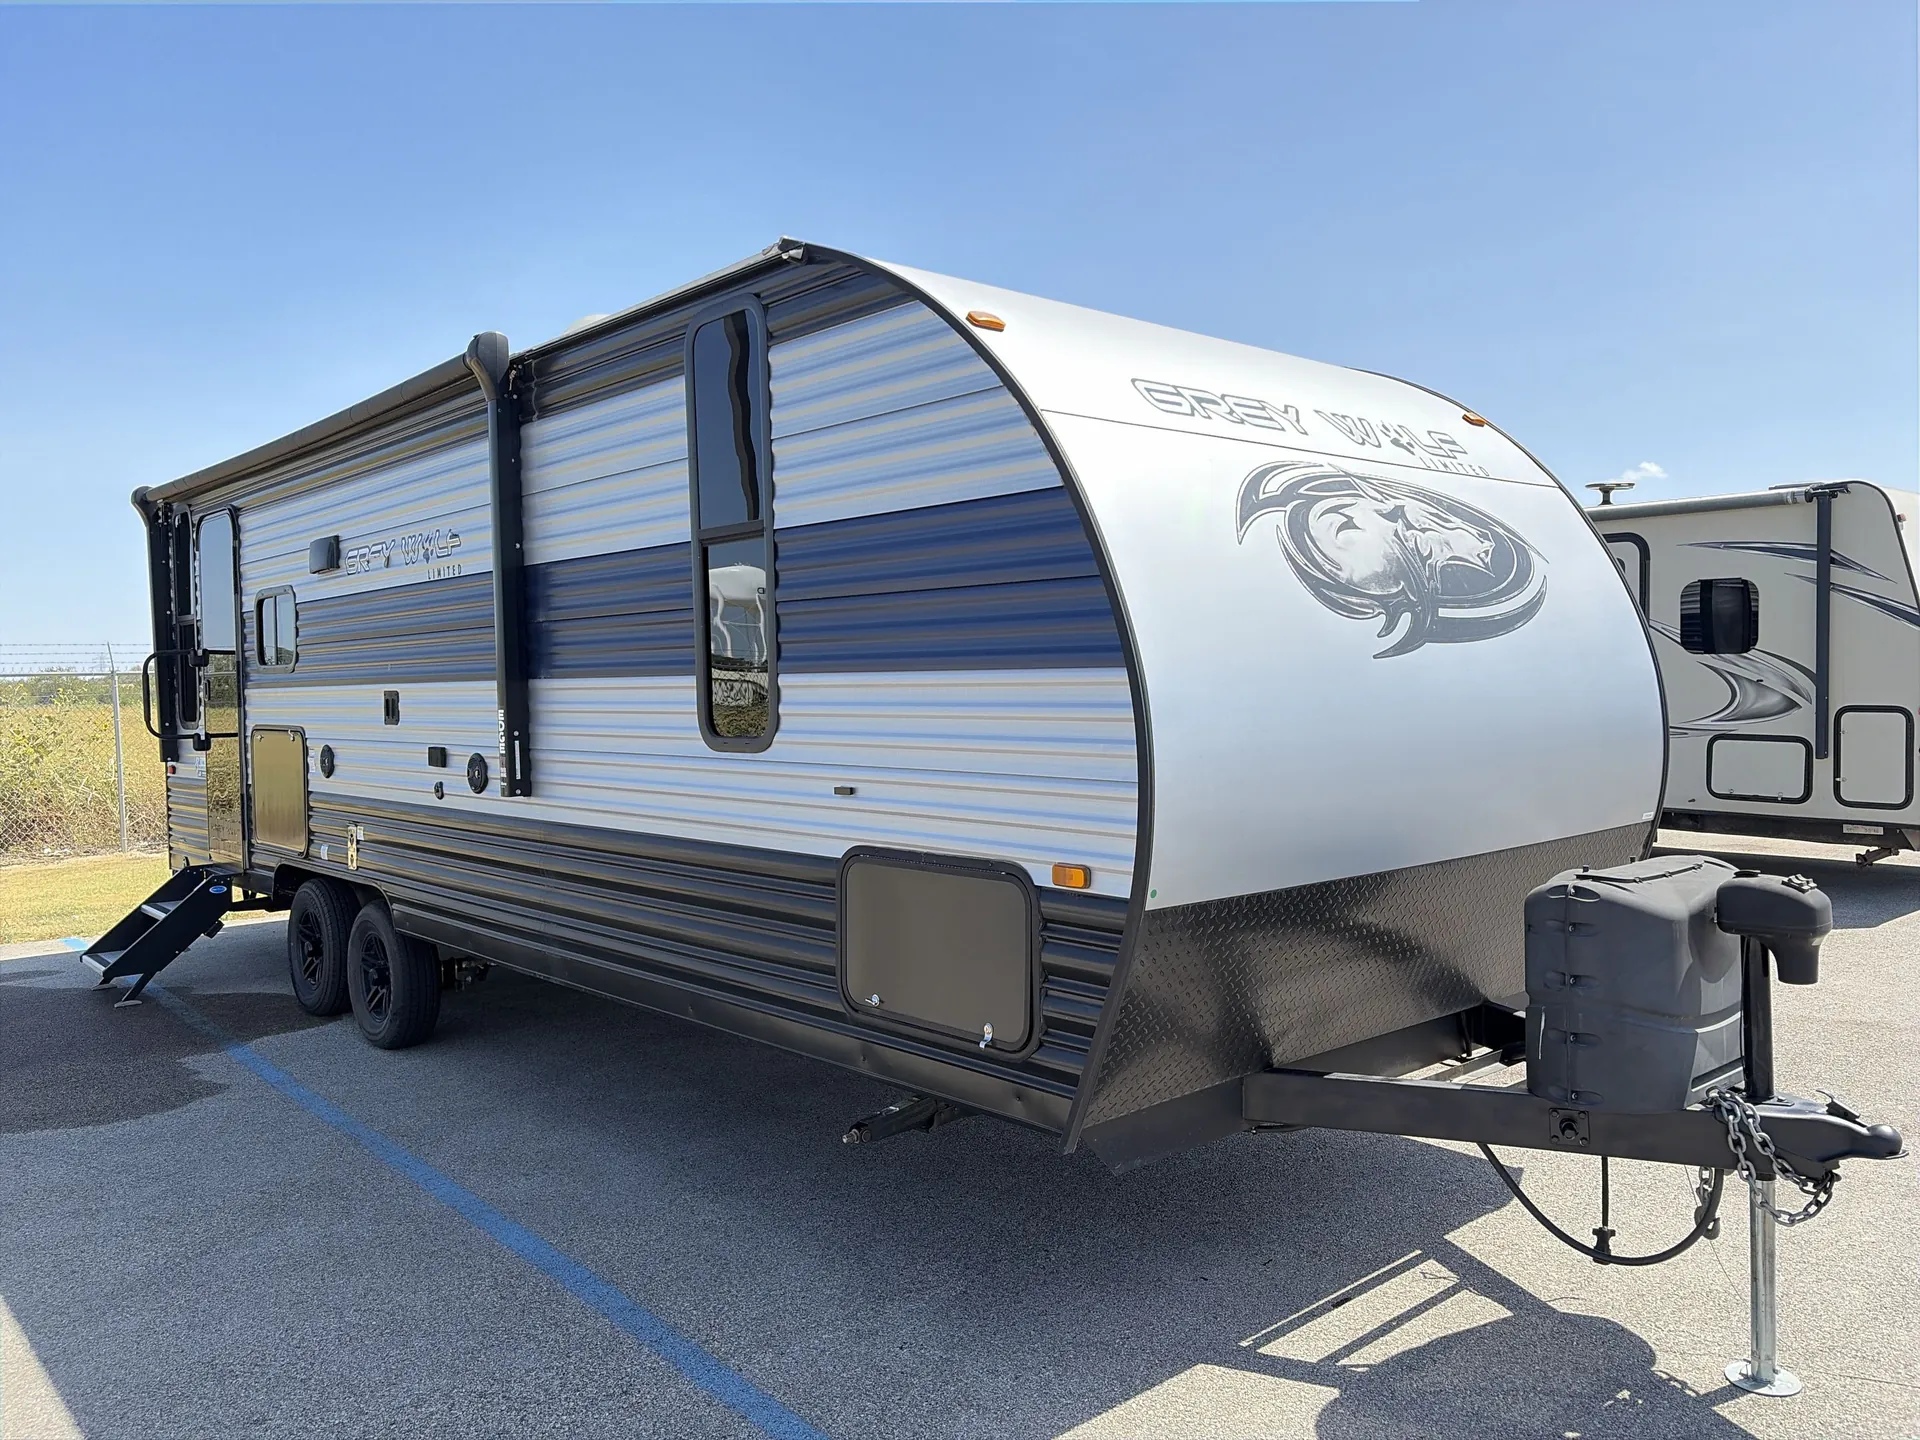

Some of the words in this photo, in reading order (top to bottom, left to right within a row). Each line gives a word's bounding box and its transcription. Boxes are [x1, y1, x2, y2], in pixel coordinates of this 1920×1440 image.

[1130, 377, 1309, 436] GREY
[1418, 455, 1491, 477] LIMITED
[427, 564, 462, 581] LIMITED
[498, 708, 506, 755] EDGE
